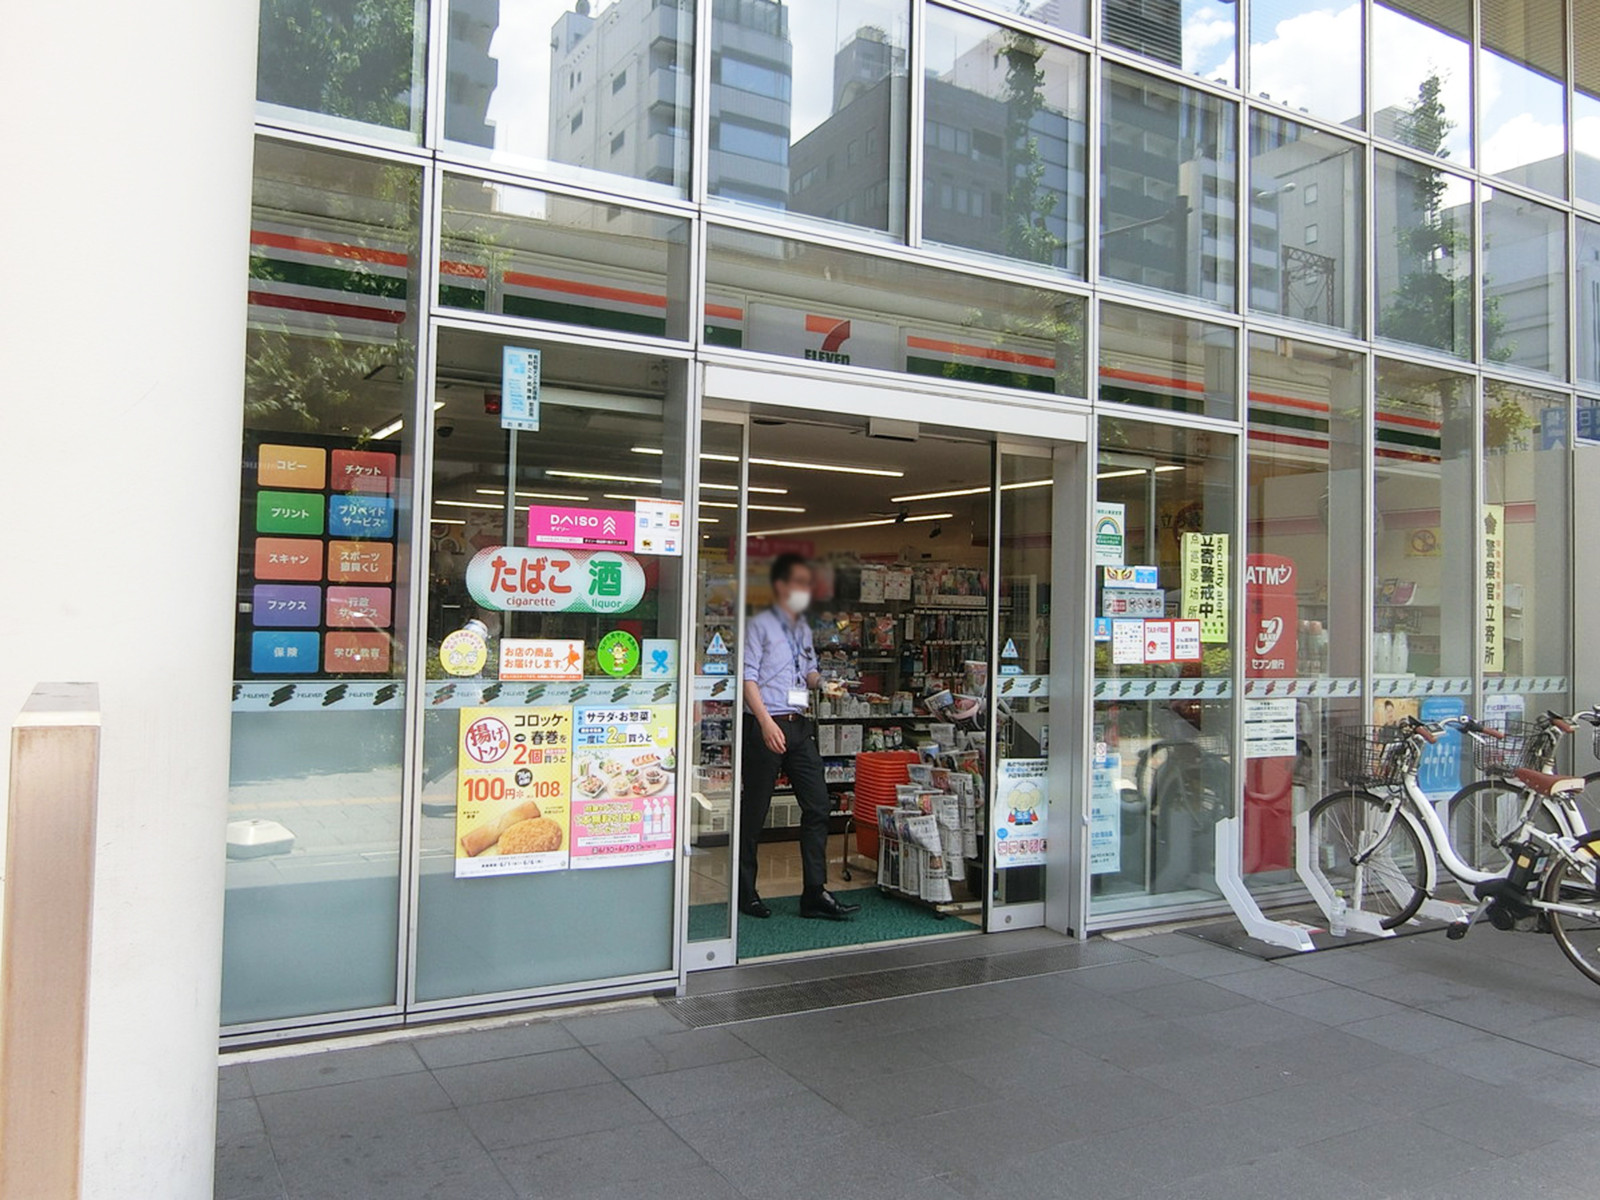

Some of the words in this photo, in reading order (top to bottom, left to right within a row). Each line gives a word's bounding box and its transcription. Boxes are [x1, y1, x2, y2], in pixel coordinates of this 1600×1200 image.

[276, 460, 307, 471] コピー
[345, 465, 381, 476] チケット
[271, 508, 310, 519] プリント
[339, 505, 385, 517] プリペイド
[342, 516, 382, 528] サービス
[551, 514, 598, 527] DAISO
[269, 553, 309, 565] スキャン
[340, 551, 381, 562] スポーツ
[1215, 538, 1225, 588] security
[491, 556, 572, 594] たばこ
[588, 559, 622, 596] 酒
[267, 600, 307, 611] ファクス
[506, 596, 556, 607] cigarette
[591, 598, 622, 609] liquor
[1216, 591, 1224, 619] alert
[1485, 539, 1495, 665] 警察官立寄所
[273, 647, 299, 658] 保険
[504, 647, 554, 658] お店の商品
[1252, 659, 1285, 669] セブン銀行
[587, 711, 649, 723] サラダ・お惣菜
[469, 723, 504, 747] 揚げ
[578, 735, 604, 744] 一度に
[628, 733, 653, 743] 買うと
[477, 746, 499, 760] トク
[513, 744, 543, 765] 2個
